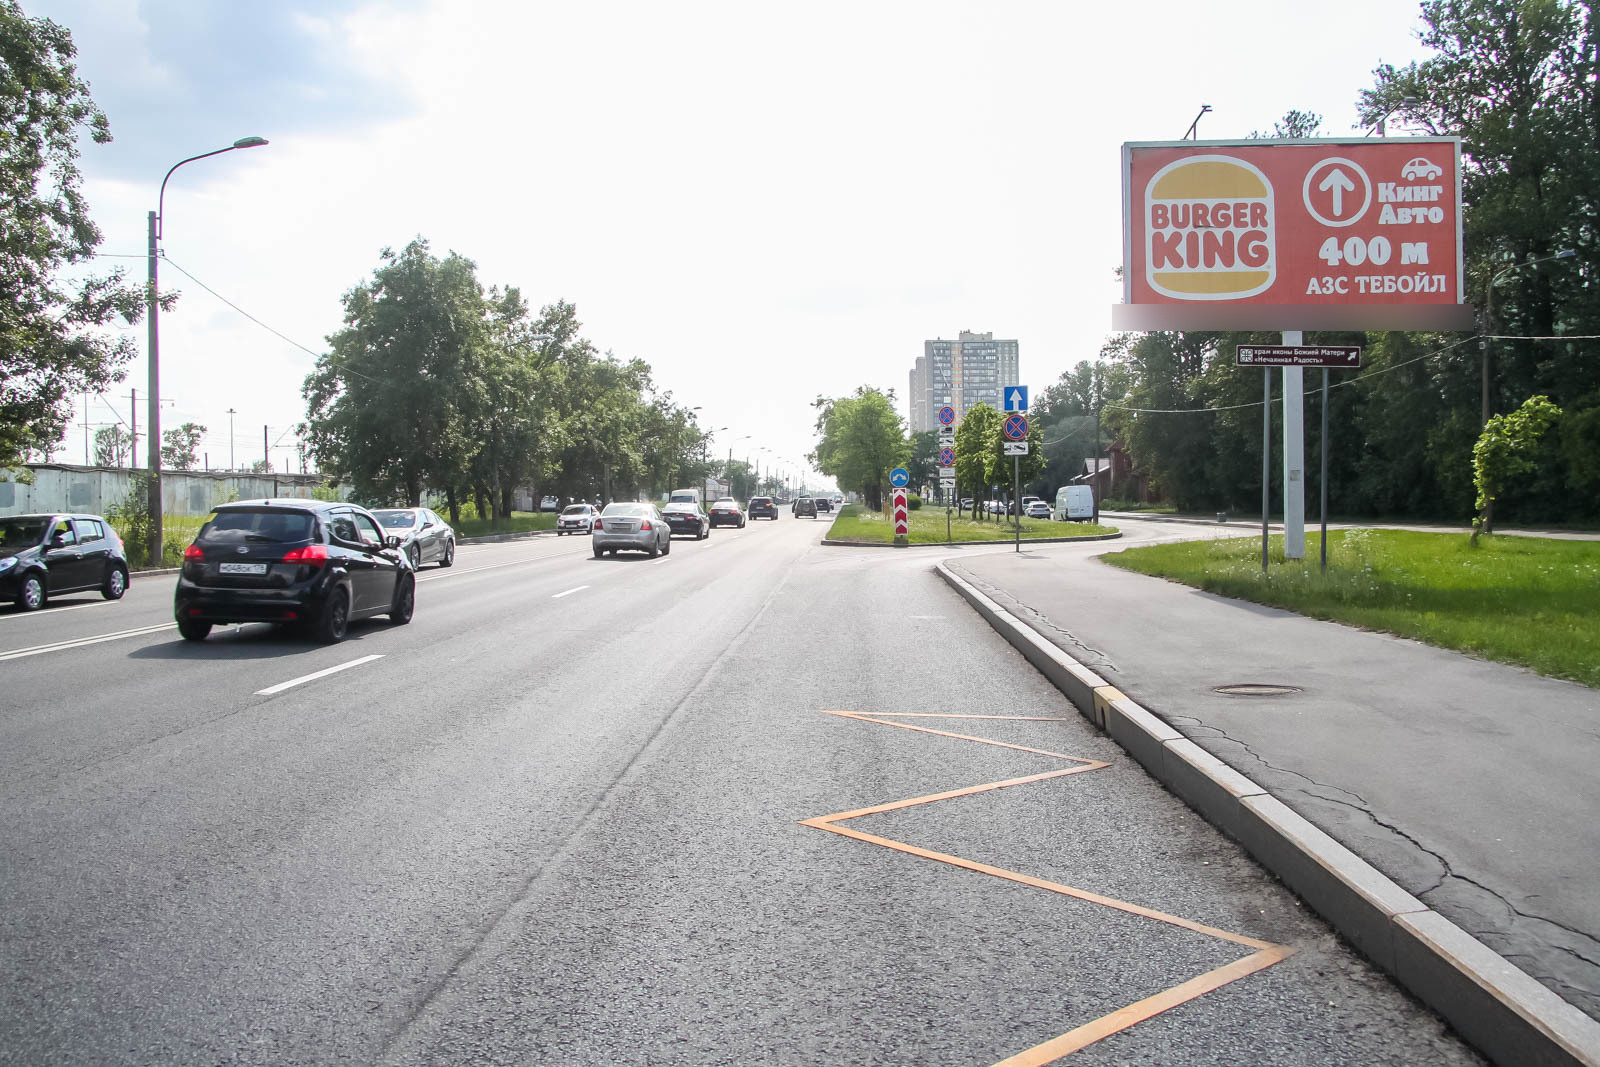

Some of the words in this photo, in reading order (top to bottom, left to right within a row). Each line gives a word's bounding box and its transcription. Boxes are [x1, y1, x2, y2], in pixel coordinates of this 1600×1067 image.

[1378, 182, 1443, 202] Кинг
[1151, 202, 1268, 229] BURGER
[1378, 204, 1444, 224] Авто
[1152, 230, 1269, 269] KING
[1319, 236, 1392, 266] 400
[1306, 276, 1349, 294] АЗС
[1354, 271, 1446, 294] ТЕБОЙЛ
[1320, 349, 1345, 357] Матери
